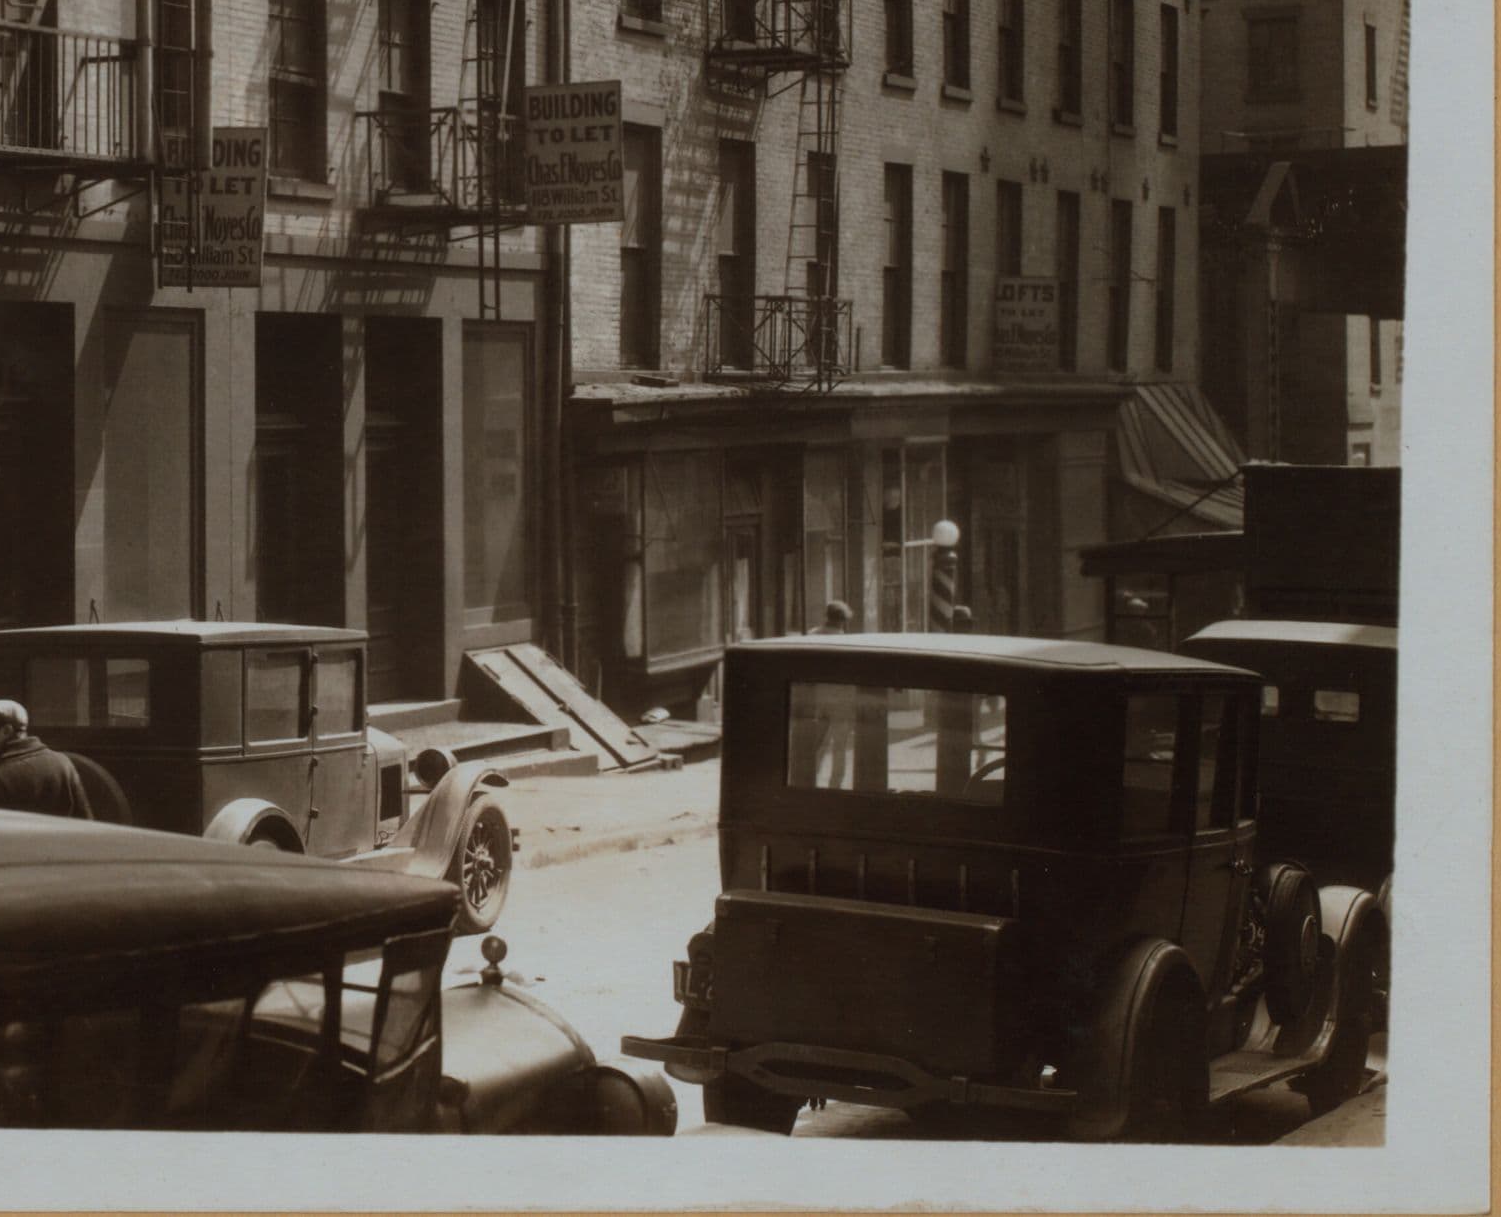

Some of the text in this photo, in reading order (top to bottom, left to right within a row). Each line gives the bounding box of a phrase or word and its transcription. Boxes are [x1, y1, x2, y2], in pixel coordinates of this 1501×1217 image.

[529, 91, 617, 120] BUILDING
[534, 124, 615, 145] TO LET
[210, 176, 257, 195] LET
[995, 284, 1054, 302] LOFTS
